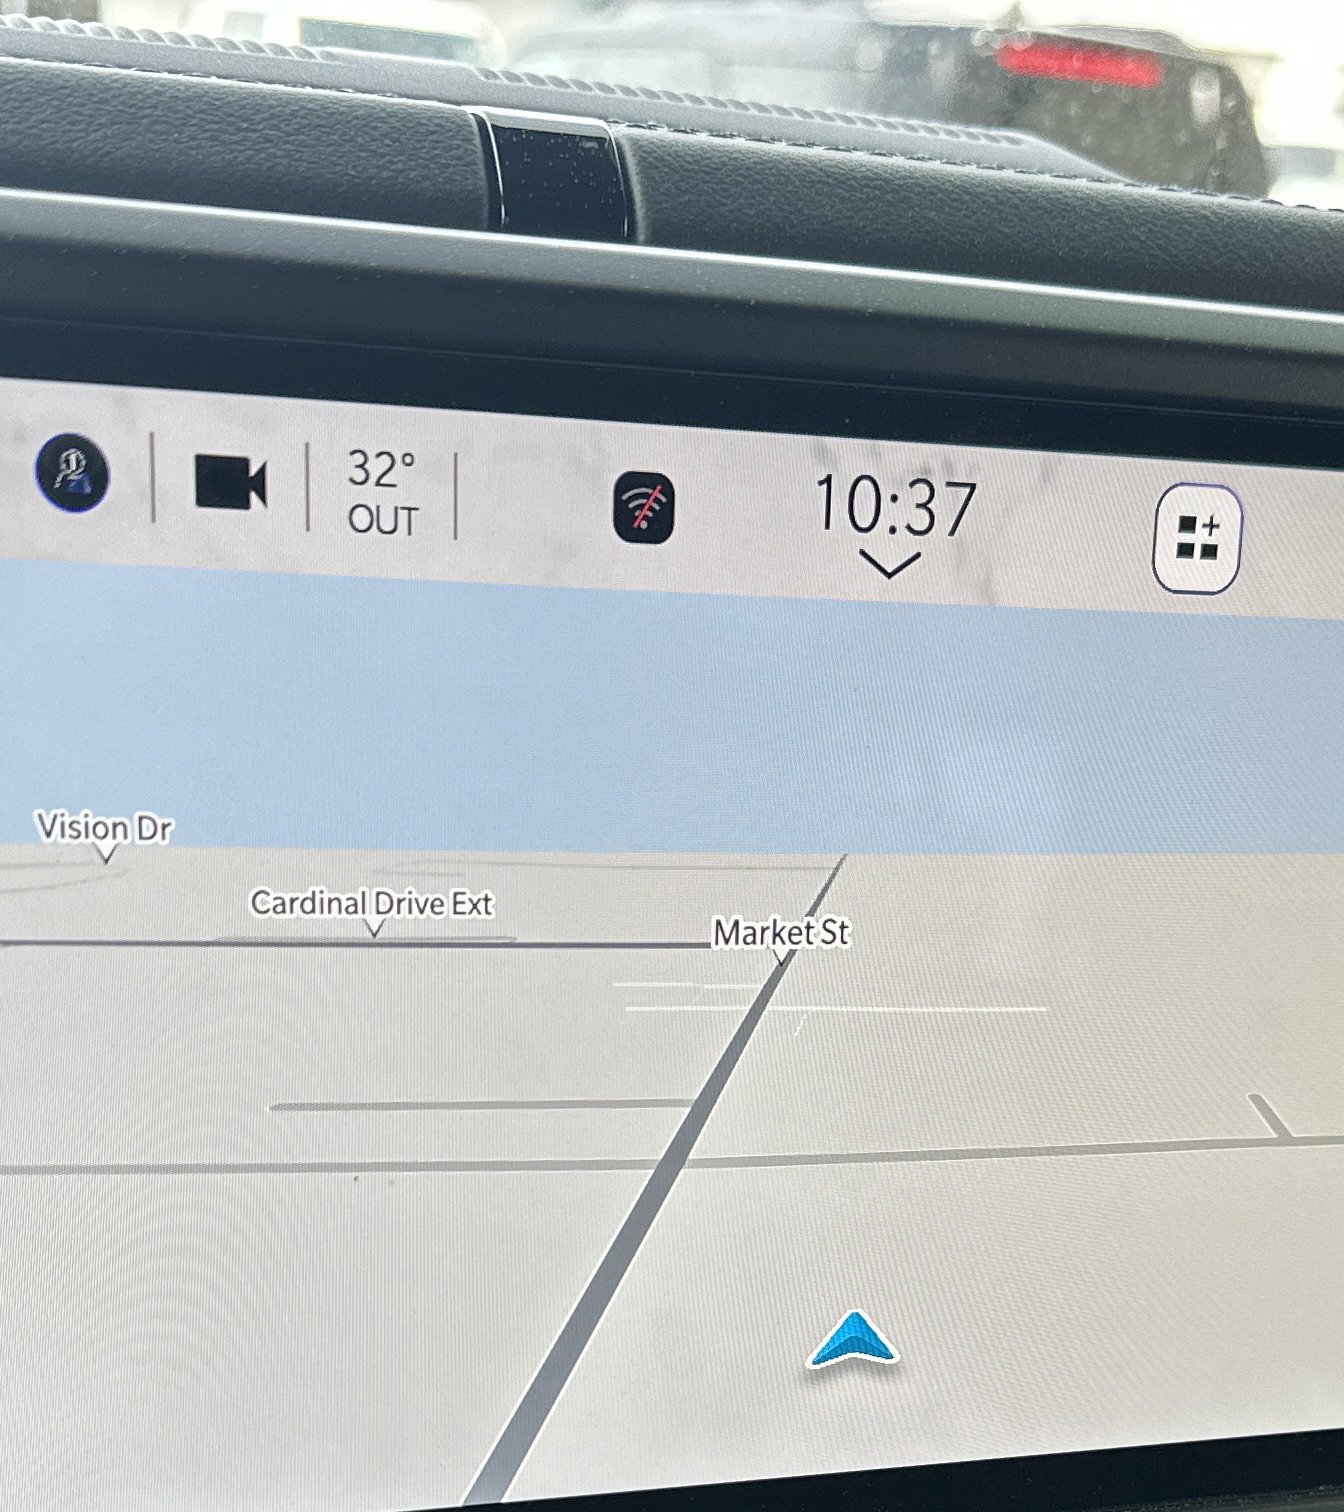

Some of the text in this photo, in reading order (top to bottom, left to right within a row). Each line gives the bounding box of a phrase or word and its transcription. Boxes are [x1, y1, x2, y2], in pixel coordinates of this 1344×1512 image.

[346, 450, 416, 490] 32°
[816, 473, 977, 537] 10:37
[348, 505, 419, 537] OUT
[38, 812, 173, 843] Vision Dr
[251, 889, 493, 917] Cardinal Drive Ext
[714, 918, 850, 949] Market St
